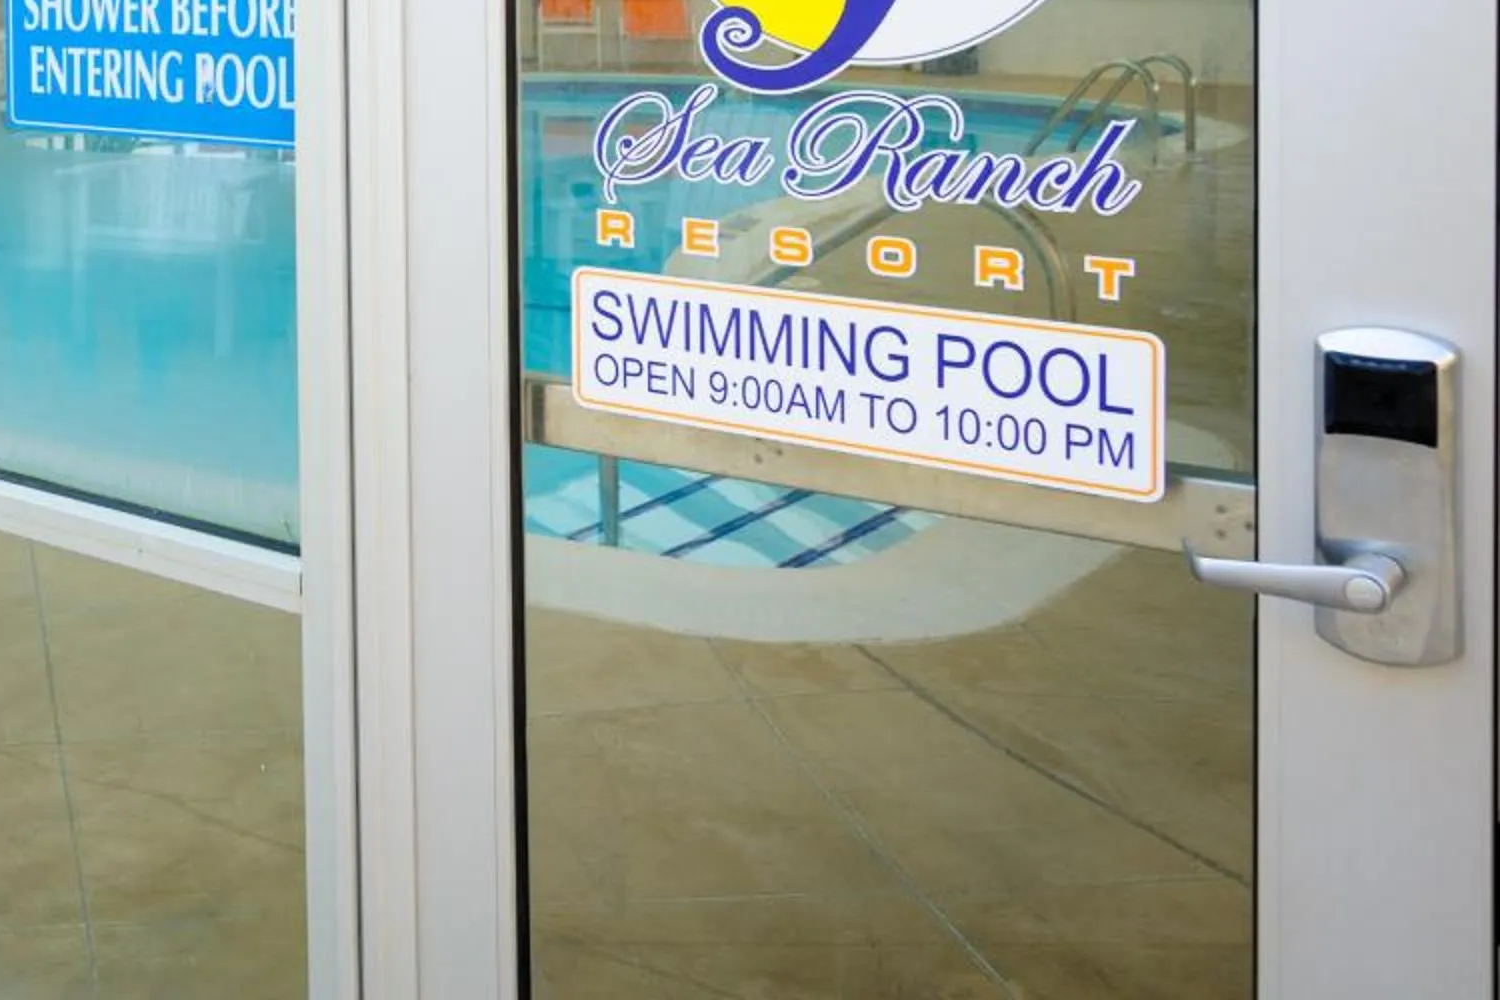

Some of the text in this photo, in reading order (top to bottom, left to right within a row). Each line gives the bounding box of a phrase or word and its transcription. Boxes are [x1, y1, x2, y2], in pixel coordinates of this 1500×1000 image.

[29, 45, 294, 110] ENTERING POOL
[593, 83, 1143, 216] Sea Ranch
[596, 207, 1136, 301] RESORT
[591, 289, 1134, 416] SWIMMING POOL
[593, 353, 1135, 470] OPEN 9:00AM TO 10:00 PM
